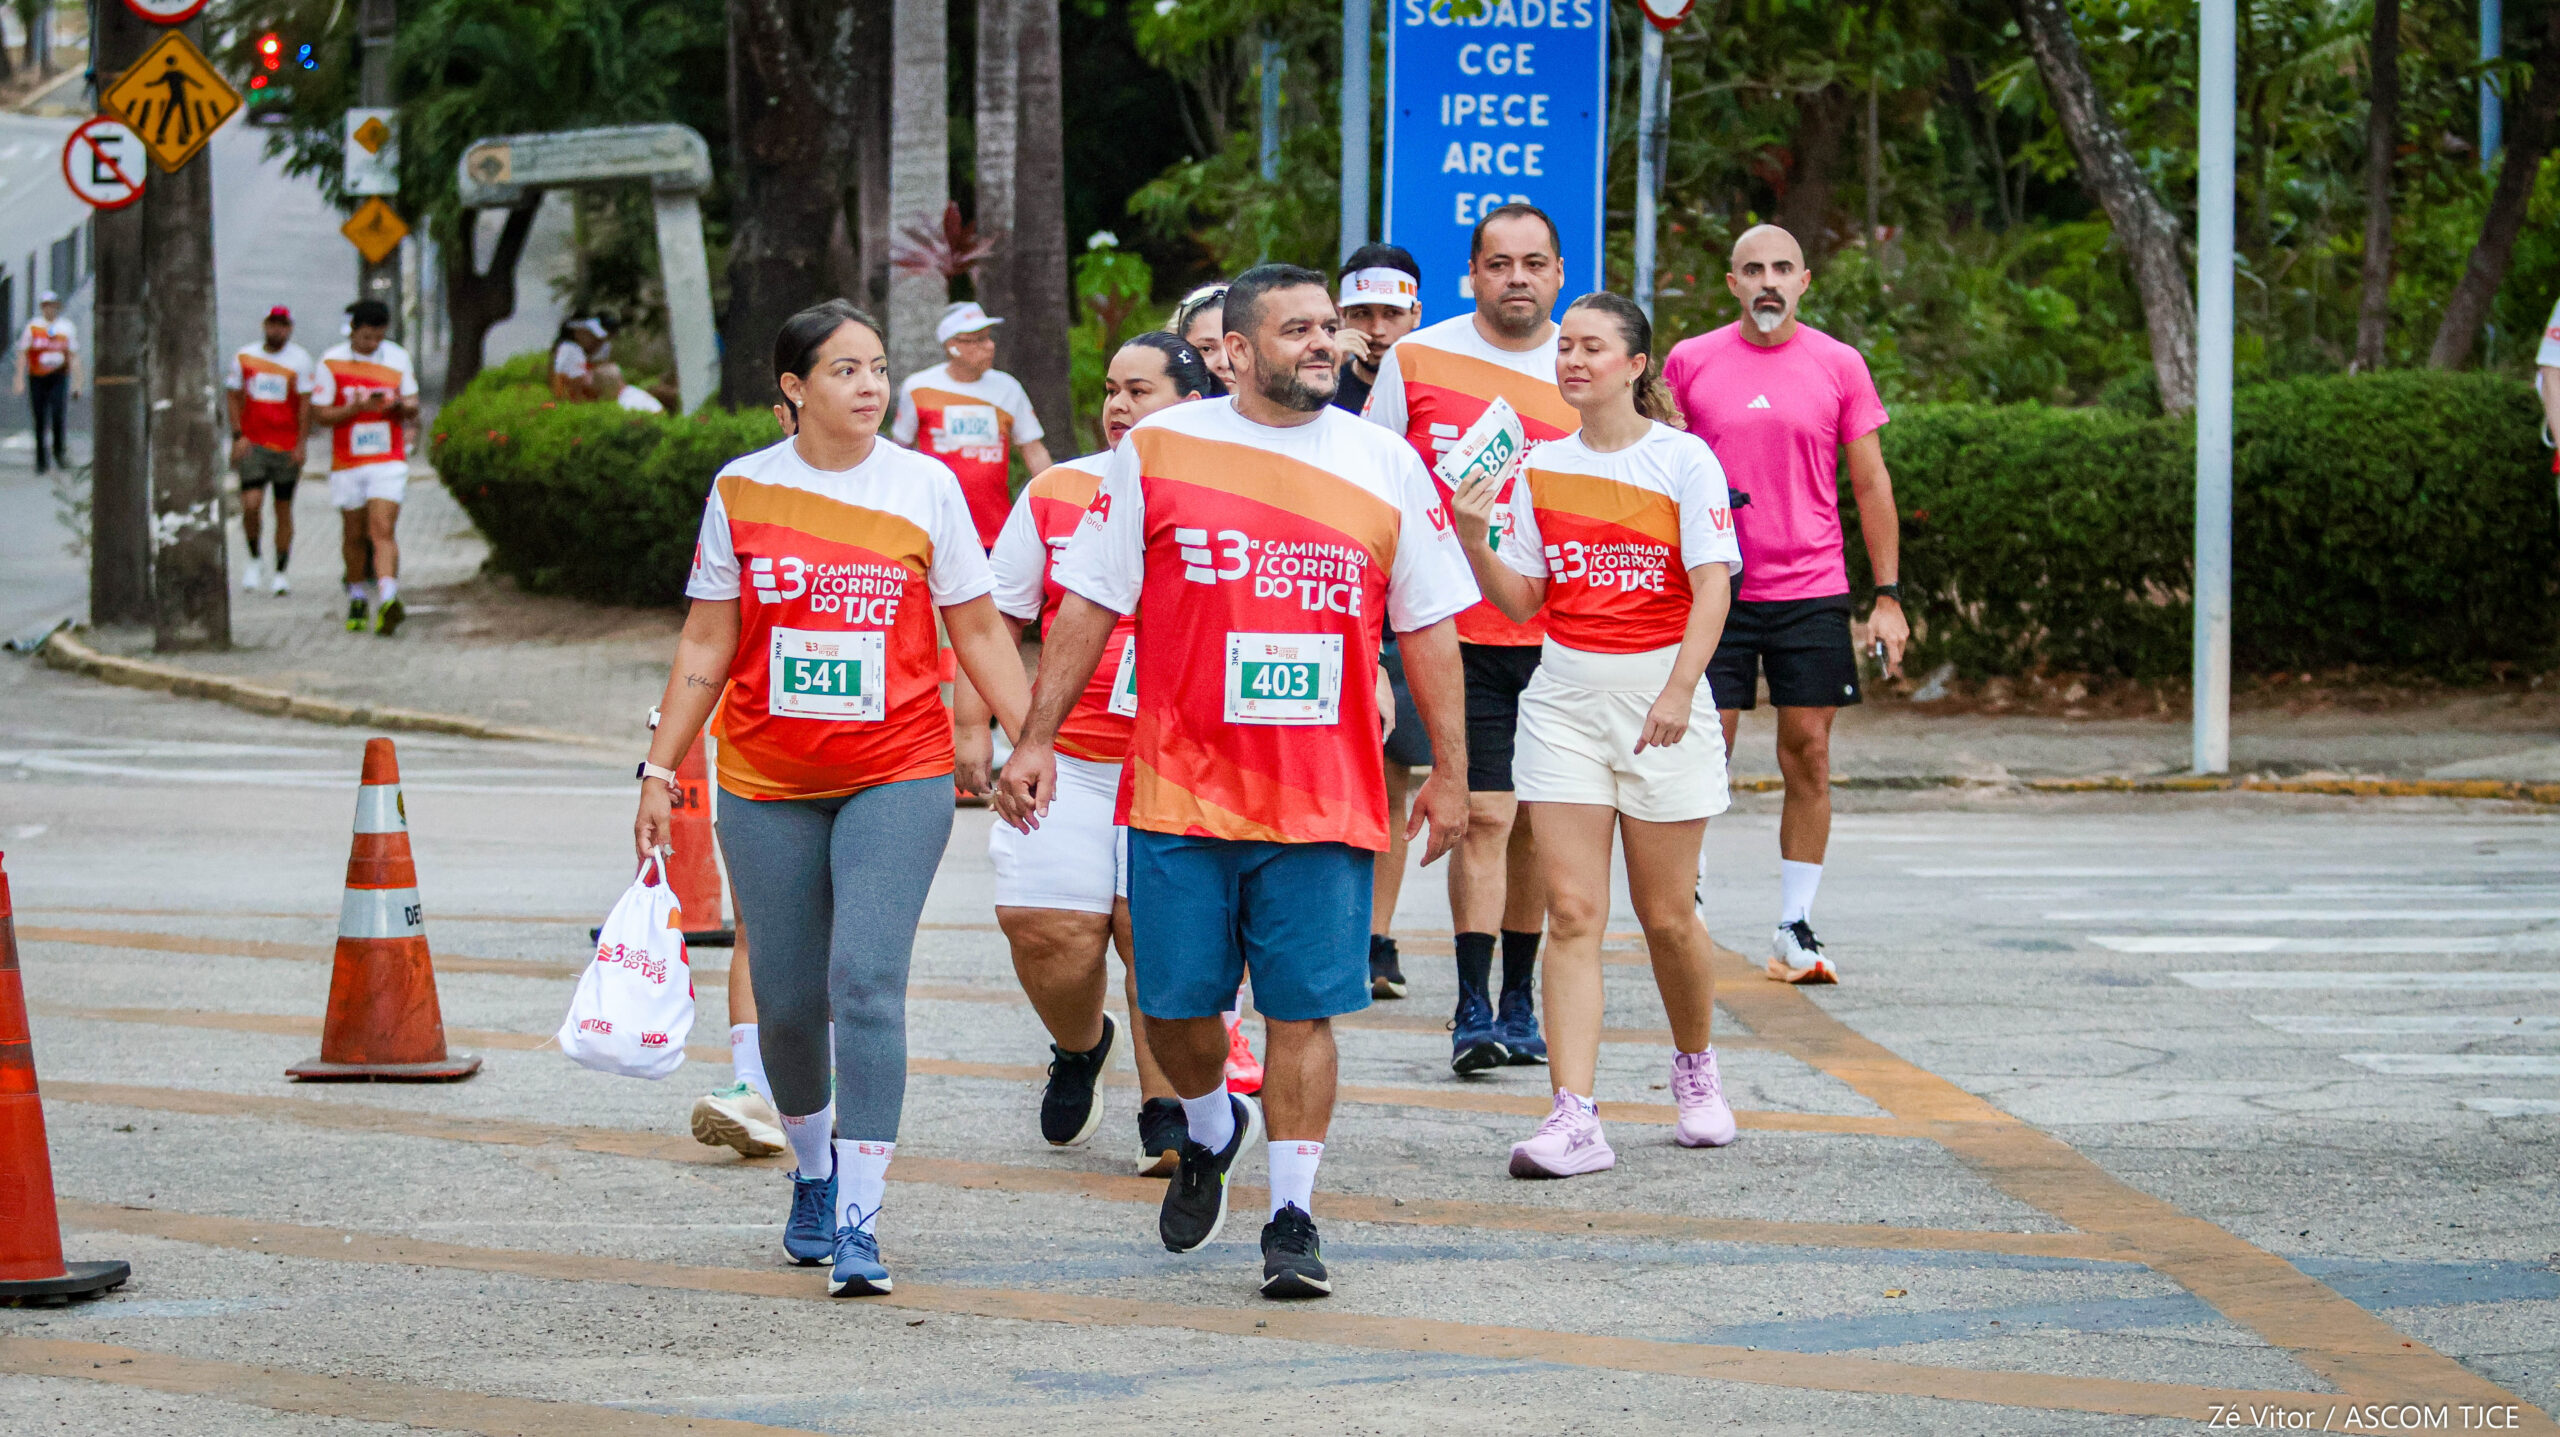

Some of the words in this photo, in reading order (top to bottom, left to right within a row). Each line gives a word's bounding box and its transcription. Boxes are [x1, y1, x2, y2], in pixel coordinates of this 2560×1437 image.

[1458, 43, 1535, 75] CGE
[1441, 94, 1549, 126] IPECE
[93, 135, 124, 184] E
[1442, 142, 1544, 176] ARCE
[1468, 437, 1509, 480] 86
[1264, 540, 1369, 568] CAMINHADA
[1592, 543, 1669, 557] CAMINHADA
[818, 563, 908, 581] CAMINHADA
[1255, 555, 1361, 584] /CORRID
[1589, 570, 1615, 587] DO
[1617, 570, 1665, 592] TJCE
[811, 577, 903, 597] /CORRIDA
[1255, 576, 1293, 599] DO
[1297, 579, 1363, 617] TJCE
[811, 594, 841, 613] DO
[844, 596, 899, 625] TJCE
[794, 660, 847, 693] 541
[1252, 664, 1309, 697] 403
[623, 960, 640, 970] DO
[591, 1020, 612, 1033] TJCE
[641, 1031, 669, 1044] VIDA
